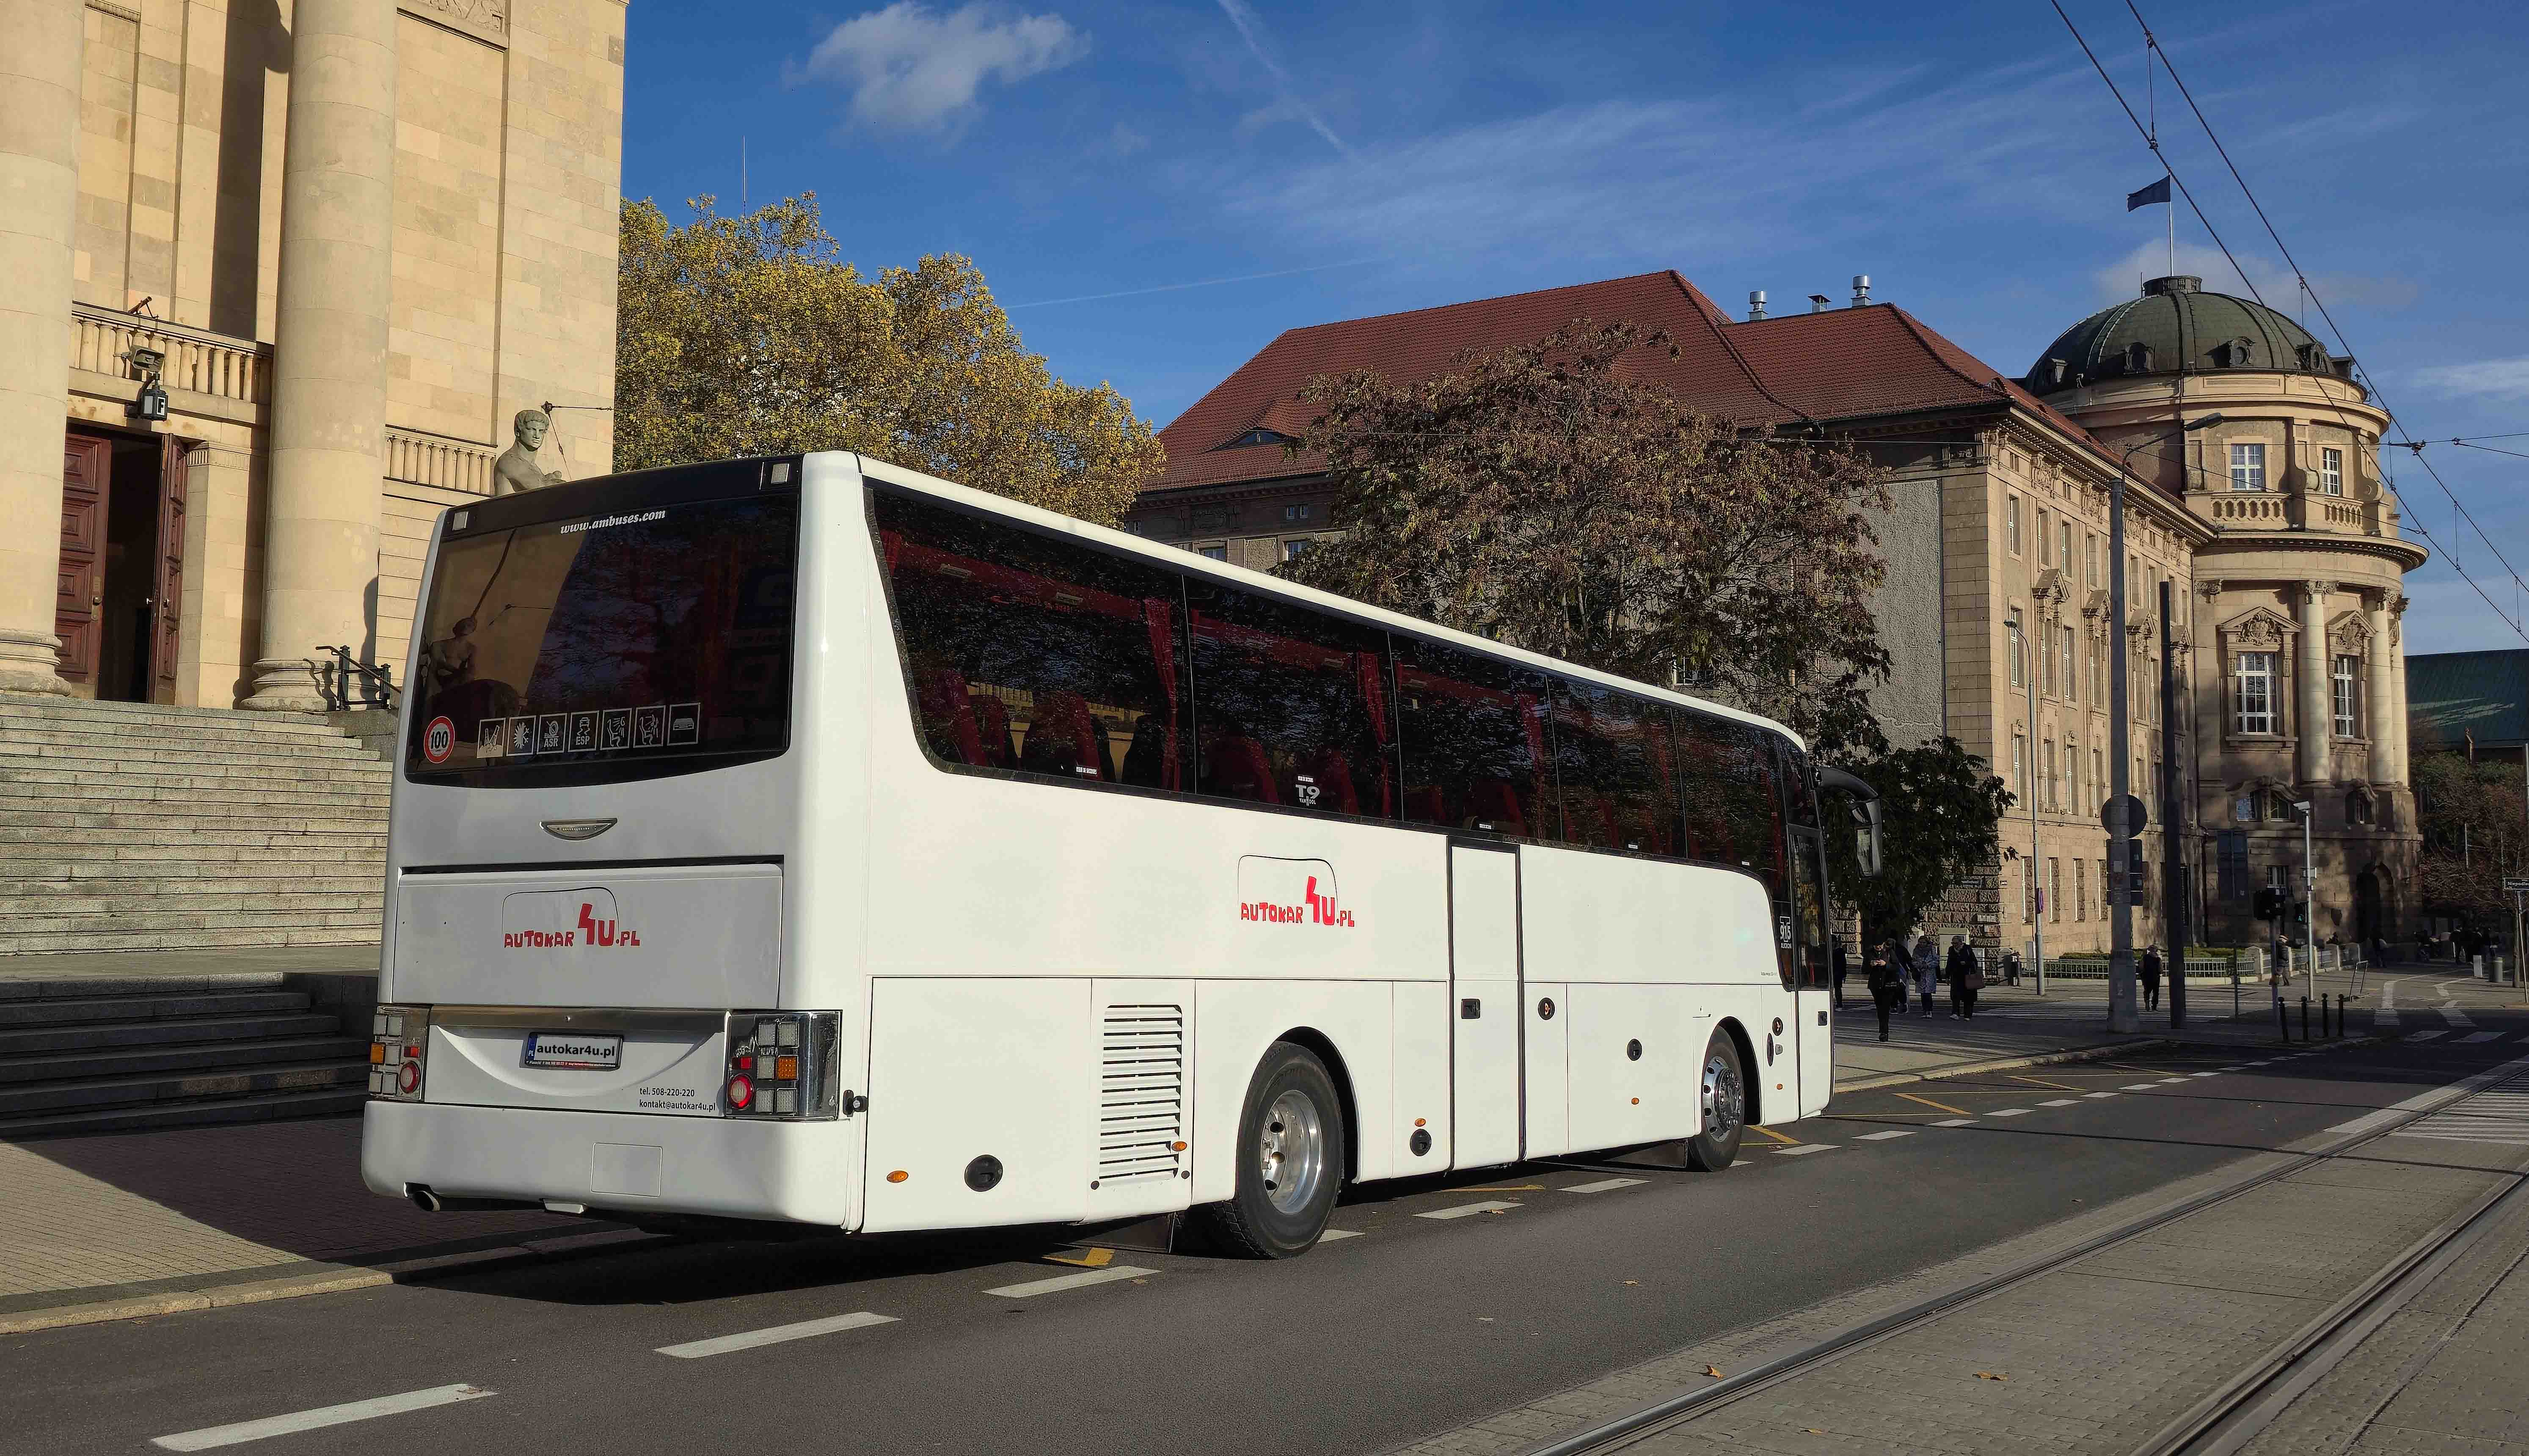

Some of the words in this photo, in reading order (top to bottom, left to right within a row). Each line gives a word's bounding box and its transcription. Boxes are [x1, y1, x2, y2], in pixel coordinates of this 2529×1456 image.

[157, 398, 165, 413] F
[560, 510, 666, 534] www.ambuses.com
[431, 731, 449, 749] 100
[544, 737, 559, 748] ASR
[576, 735, 590, 746] ESP
[1295, 784, 1320, 799] T9
[537, 1044, 615, 1058] autokar4u.pl
[639, 1087, 650, 1095] tel.
[651, 1087, 695, 1097] 508-220-220
[639, 1099, 716, 1112] kontakt@autokar4u.pl
